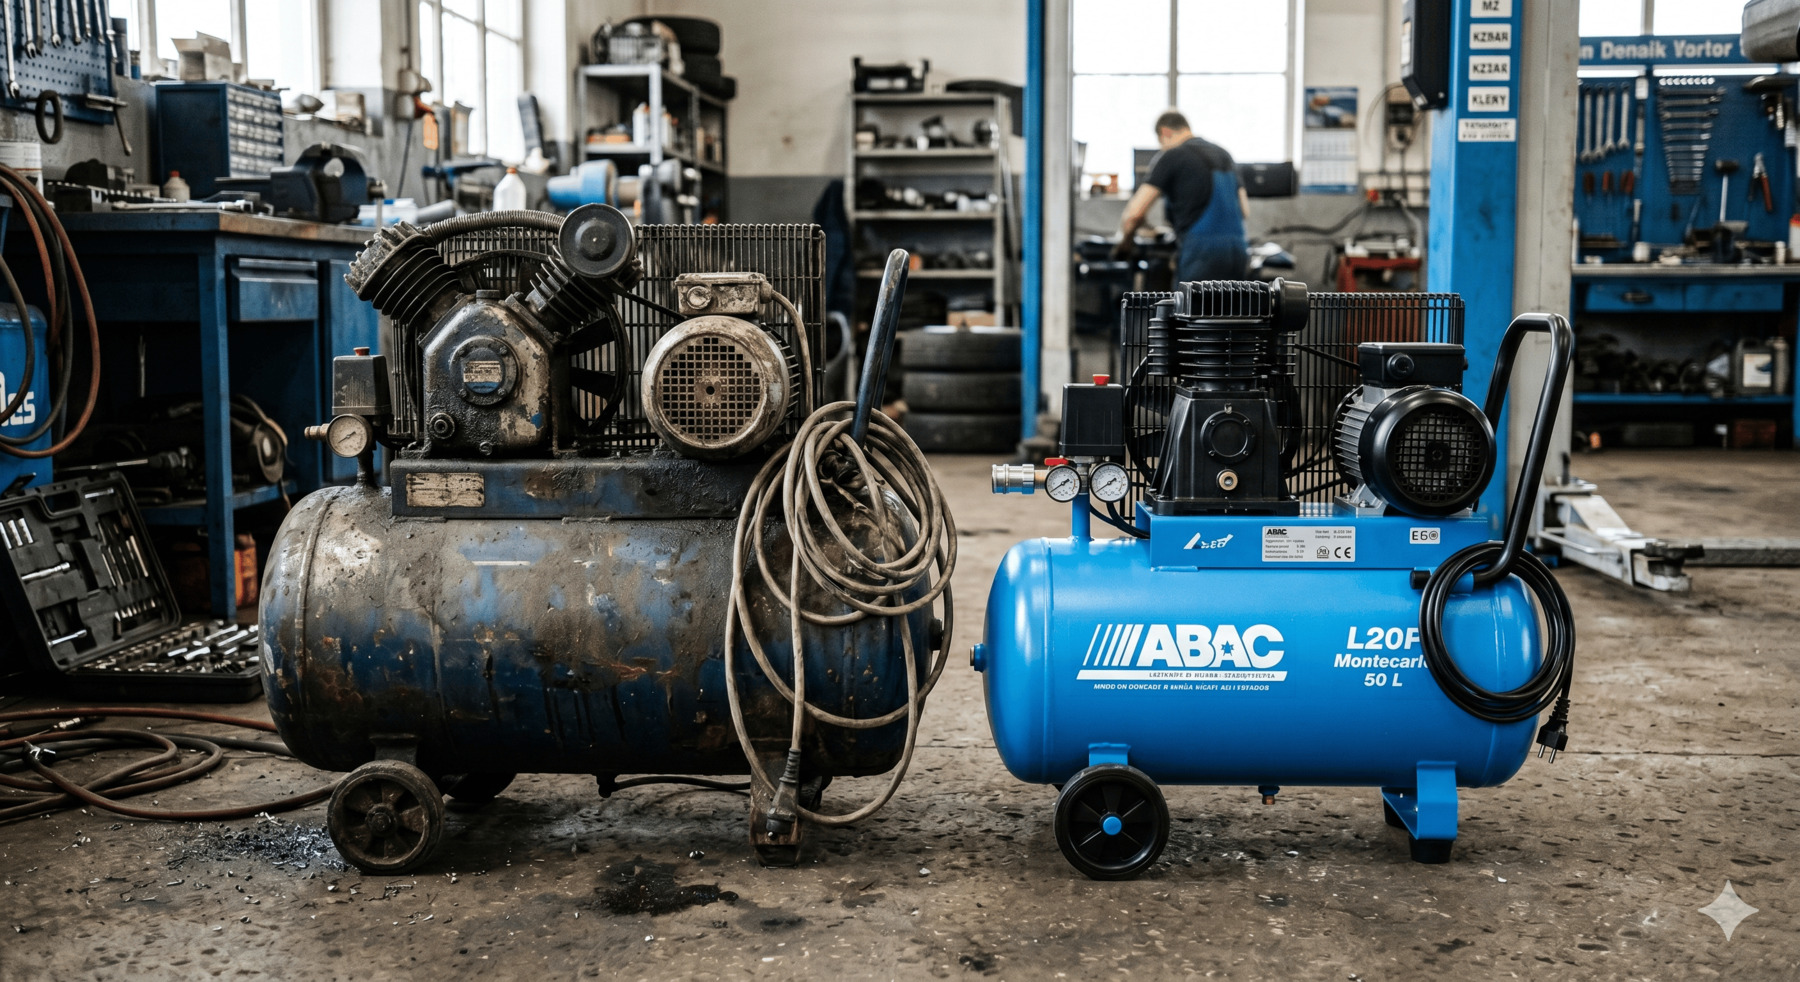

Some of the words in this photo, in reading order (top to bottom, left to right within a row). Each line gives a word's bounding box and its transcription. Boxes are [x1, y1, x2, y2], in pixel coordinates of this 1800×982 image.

[1266, 528, 1288, 536] ABAC
[1136, 624, 1284, 669] ABAC
[1363, 672, 1388, 688] 50
[1391, 672, 1404, 688] L
